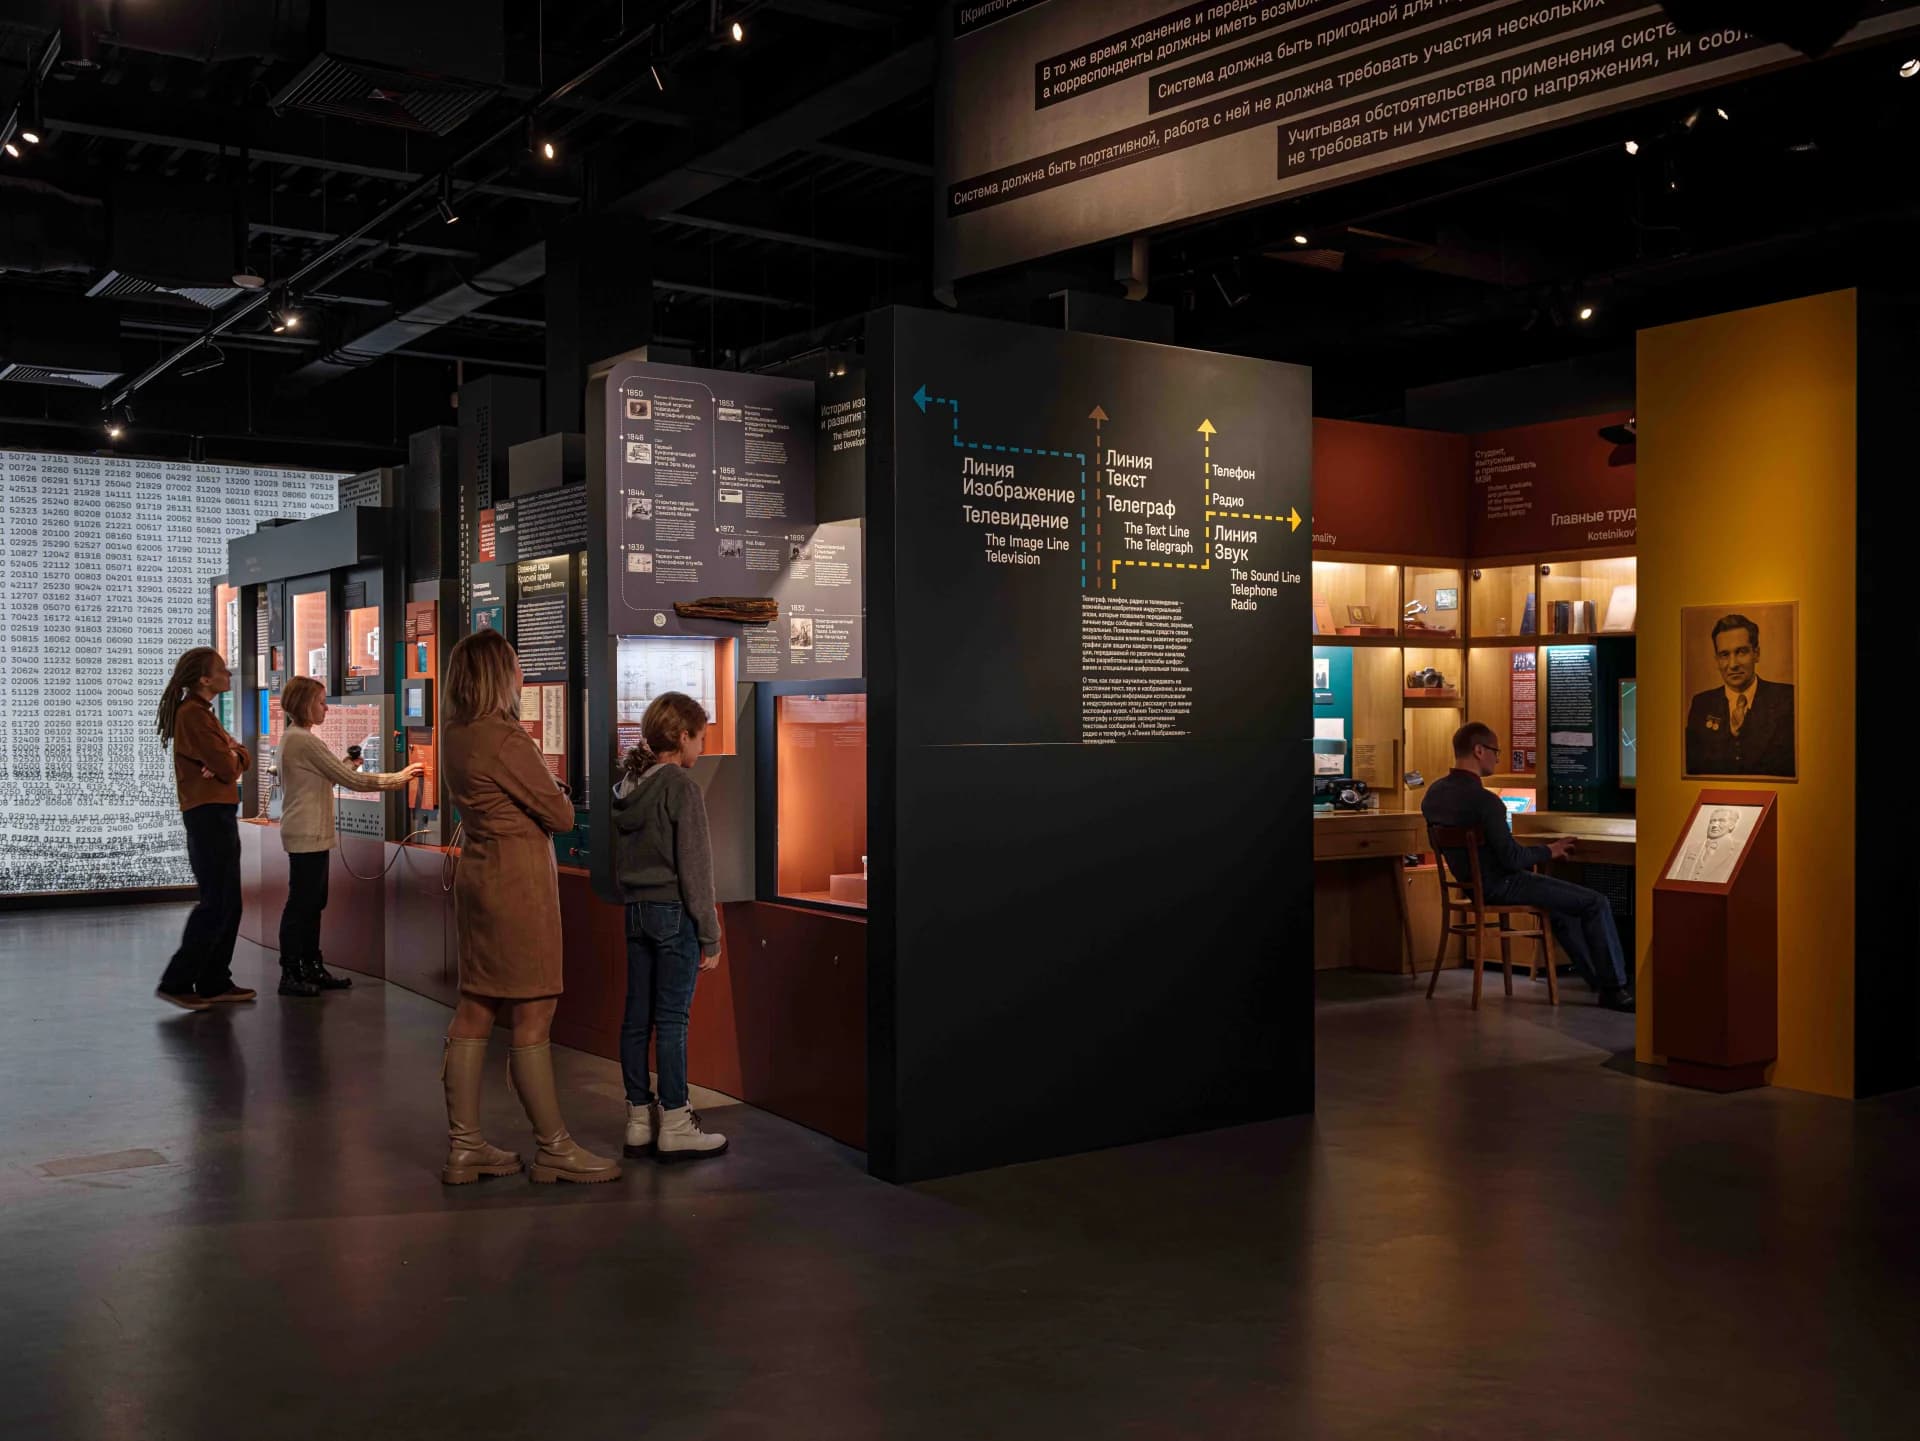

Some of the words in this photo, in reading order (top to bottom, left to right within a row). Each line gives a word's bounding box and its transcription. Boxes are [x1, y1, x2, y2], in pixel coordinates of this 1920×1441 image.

[1043, 66, 1050, 81] В
[1053, 61, 1067, 76] то
[1070, 55, 1087, 71] же
[1090, 40, 1127, 65] время
[1130, 15, 1191, 50] хранение
[1195, 12, 1203, 24] и
[1158, 70, 1214, 98] Система
[1218, 51, 1273, 81] должна
[1277, 38, 1313, 59] быть
[1317, 4, 1398, 46] пригодной
[1402, 0, 1433, 20] для
[1043, 86, 1050, 98] а
[1053, 50, 1153, 96] корреспонденты
[1157, 30, 1211, 61] должны
[1215, 14, 1257, 38] иметь
[1288, 112, 1360, 146] Учитывая
[1365, 74, 1495, 123] обстоятельства
[1501, 40, 1614, 85] применения
[1621, 22, 1679, 49] систе
[1288, 150, 1305, 166] не
[1310, 128, 1388, 161] требовать
[1393, 121, 1413, 136] ни
[1418, 87, 1527, 133] умственного
[1534, 52, 1659, 98] напряжения,
[1668, 41, 1691, 61] ни
[954, 181, 999, 205] Система
[1001, 168, 1045, 193] должна
[1048, 159, 1076, 176] быть
[1079, 130, 1160, 169] портативной,
[1164, 115, 1209, 143] работа
[1213, 112, 1221, 126] с
[1225, 101, 1250, 122] ней
[1254, 96, 1271, 113] не
[1275, 78, 1333, 109] должна
[1337, 51, 1418, 88] требовать
[1424, 27, 1492, 63] участия
[627, 389, 644, 397] 1850
[828, 412, 861, 430] развития
[962, 457, 1014, 478] Линия
[1105, 449, 1152, 470] Линия
[1212, 464, 1256, 480] Телефон
[1482, 462, 1536, 475] преподаватель
[226, 477, 250, 485] 13200
[1105, 468, 1147, 488] Текст
[41, 487, 69, 495] 22121
[166, 484, 192, 492] 07002
[628, 488, 645, 496] 1844
[963, 477, 1075, 503] Изображение
[1105, 494, 1176, 519] Телеграф
[1212, 493, 1244, 508] Радио
[10, 517, 38, 525] 72010
[962, 505, 1069, 530] Телевидение
[1551, 511, 1604, 526] Главные
[42, 529, 70, 537] 20100
[167, 535, 192, 543] 17112
[197, 536, 221, 544] 70213
[1124, 521, 1143, 534] The
[1145, 523, 1166, 536] Text
[1169, 525, 1190, 538] Line
[1214, 525, 1257, 544] Линия
[985, 533, 1006, 546] The
[1009, 534, 1043, 551] Image
[1047, 537, 1070, 550] Line
[1124, 537, 1143, 550] The
[1145, 538, 1193, 556] Telegraph
[197, 547, 222, 555] 10112
[985, 549, 1040, 565] Television
[1215, 543, 1248, 563] Звук
[43, 561, 70, 569] 22112
[167, 566, 192, 574] 12031
[1231, 568, 1247, 581] The
[1250, 569, 1279, 582] Sound
[1282, 571, 1301, 583] Line
[1231, 584, 1277, 597] Telephone
[1231, 598, 1257, 611] Radio
[167, 617, 193, 625] 27012
[44, 656, 71, 664] 11232
[44, 667, 71, 675] 22012
[11, 709, 39, 717] 72213
[76, 709, 102, 717] 01721
